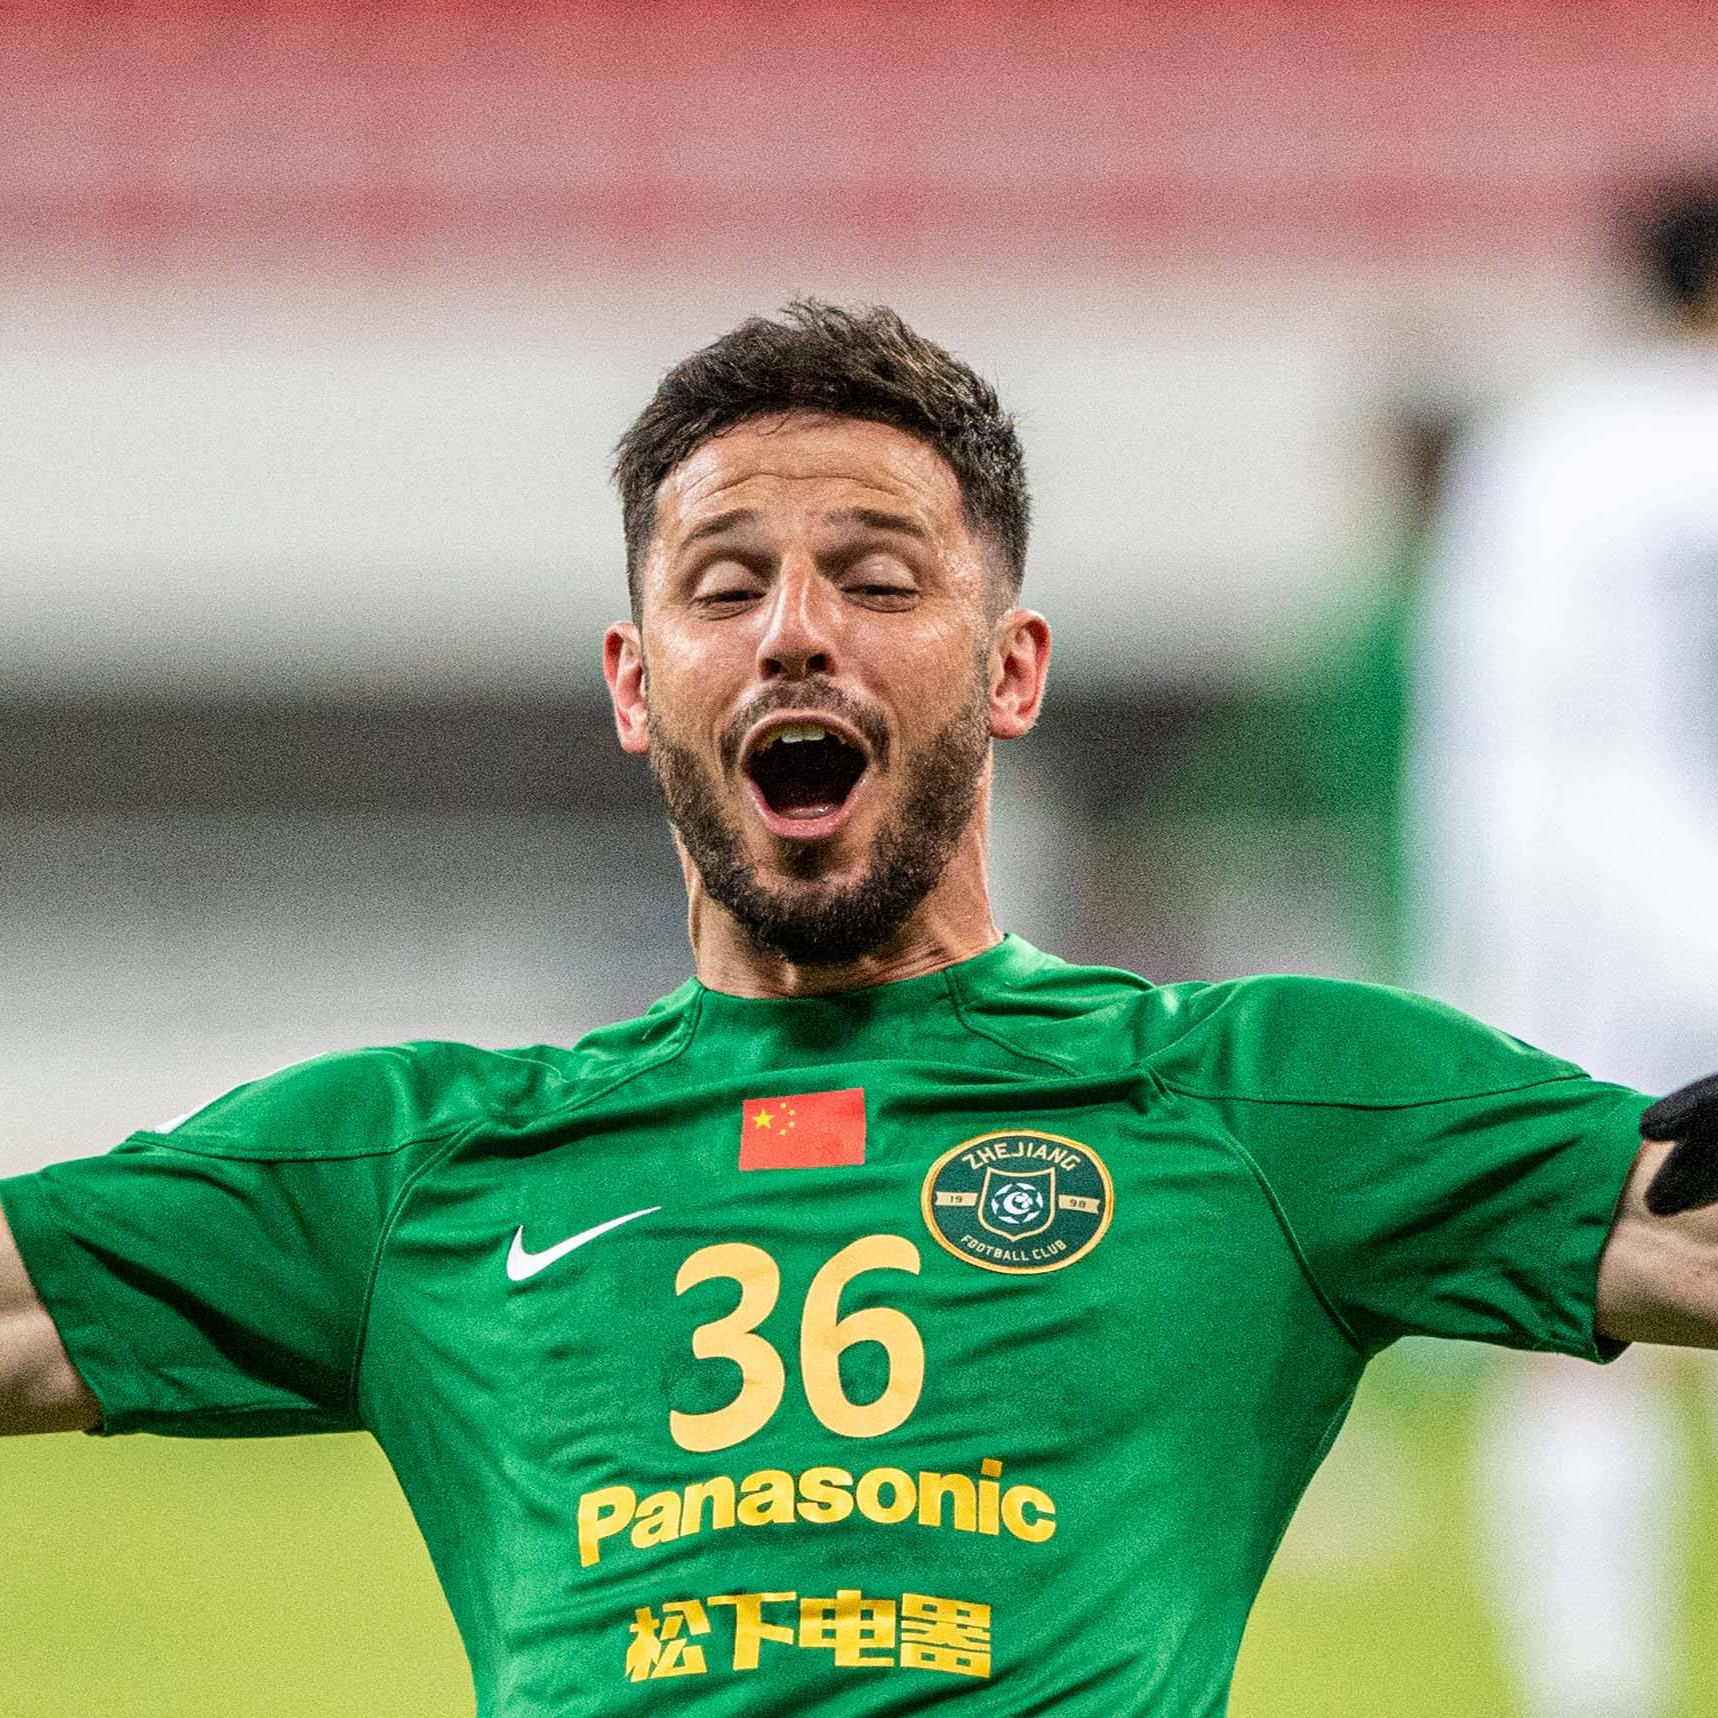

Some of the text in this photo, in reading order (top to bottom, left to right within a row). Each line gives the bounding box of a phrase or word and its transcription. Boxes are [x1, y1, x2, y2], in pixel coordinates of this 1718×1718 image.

[961, 1142, 1081, 1172] ZHEJIANG
[1069, 1199, 1086, 1208] 98
[960, 1234, 1067, 1261] FOOTBALL CLUB
[670, 1234, 925, 1453] 36
[577, 1459, 1057, 1567] Panasonic
[625, 1589, 992, 1683] 松下电器
